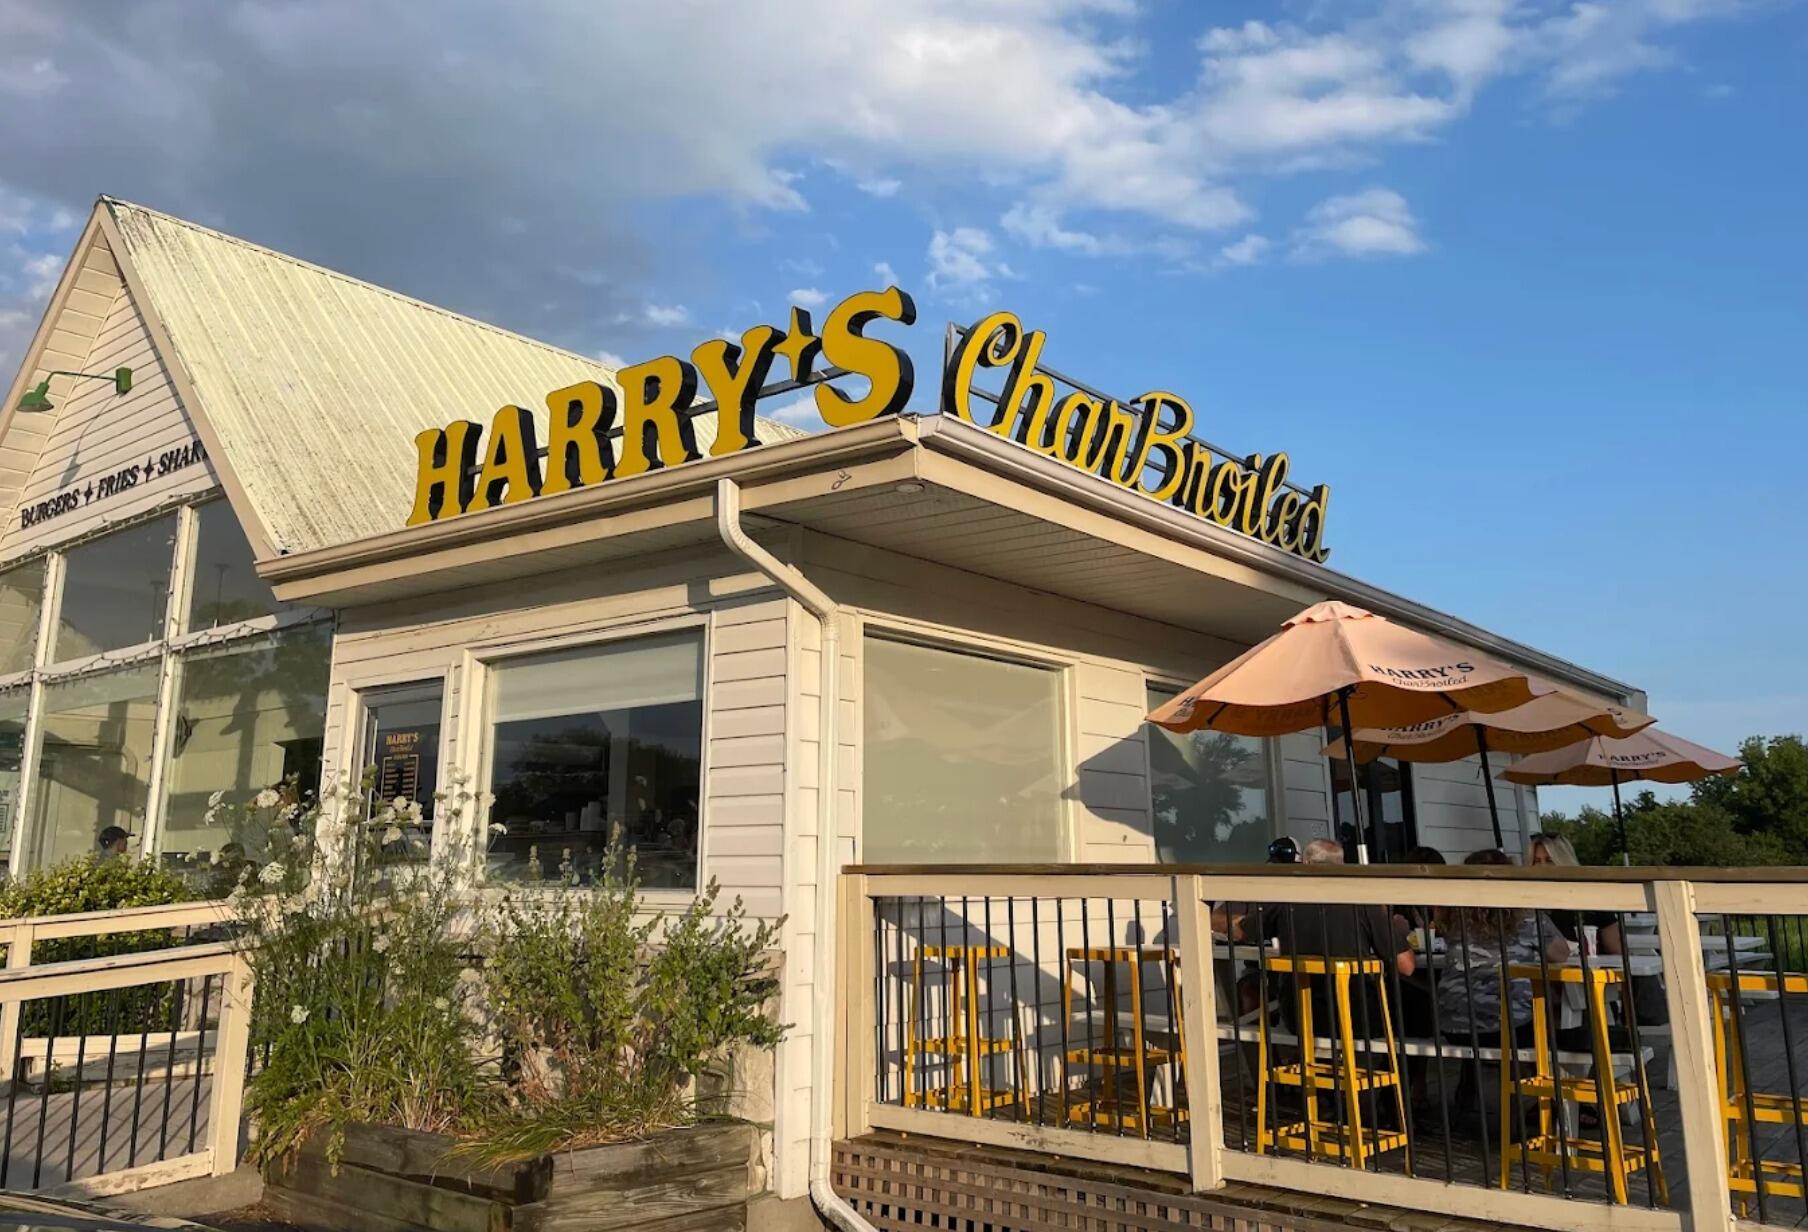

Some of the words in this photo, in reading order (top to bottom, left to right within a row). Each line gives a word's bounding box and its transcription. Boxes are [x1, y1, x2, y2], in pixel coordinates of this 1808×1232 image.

[406, 286, 915, 526] HARRY'S
[942, 311, 1330, 564] CharBroiled
[21, 488, 80, 529] BURGERS
[96, 464, 140, 500] FRIES
[1368, 662, 1475, 679] HARRY'S
